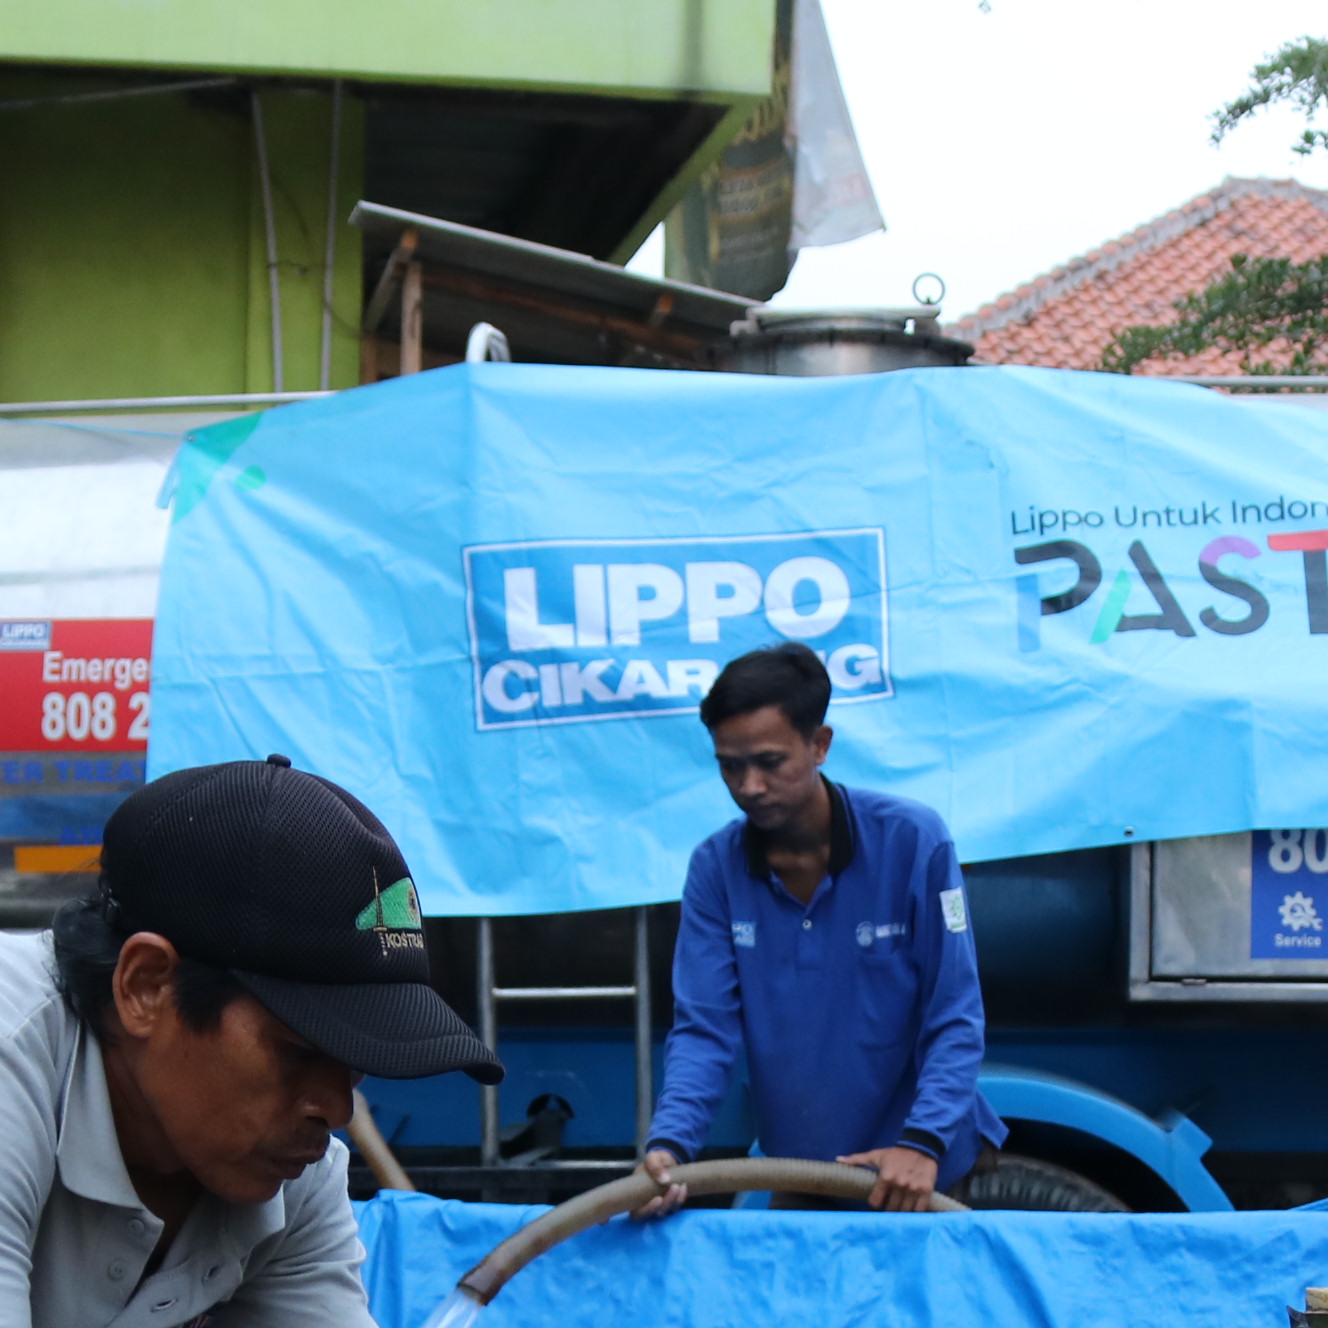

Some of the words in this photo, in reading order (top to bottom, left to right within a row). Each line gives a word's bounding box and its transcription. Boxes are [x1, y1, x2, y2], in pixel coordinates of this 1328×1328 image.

[1011, 506, 1104, 535] Lippo
[1114, 500, 1221, 528] Untuk
[503, 556, 851, 652] LIPPO
[481, 643, 883, 714] CIKARG
[41, 691, 117, 741] 808
[1274, 933, 1322, 948] Service
